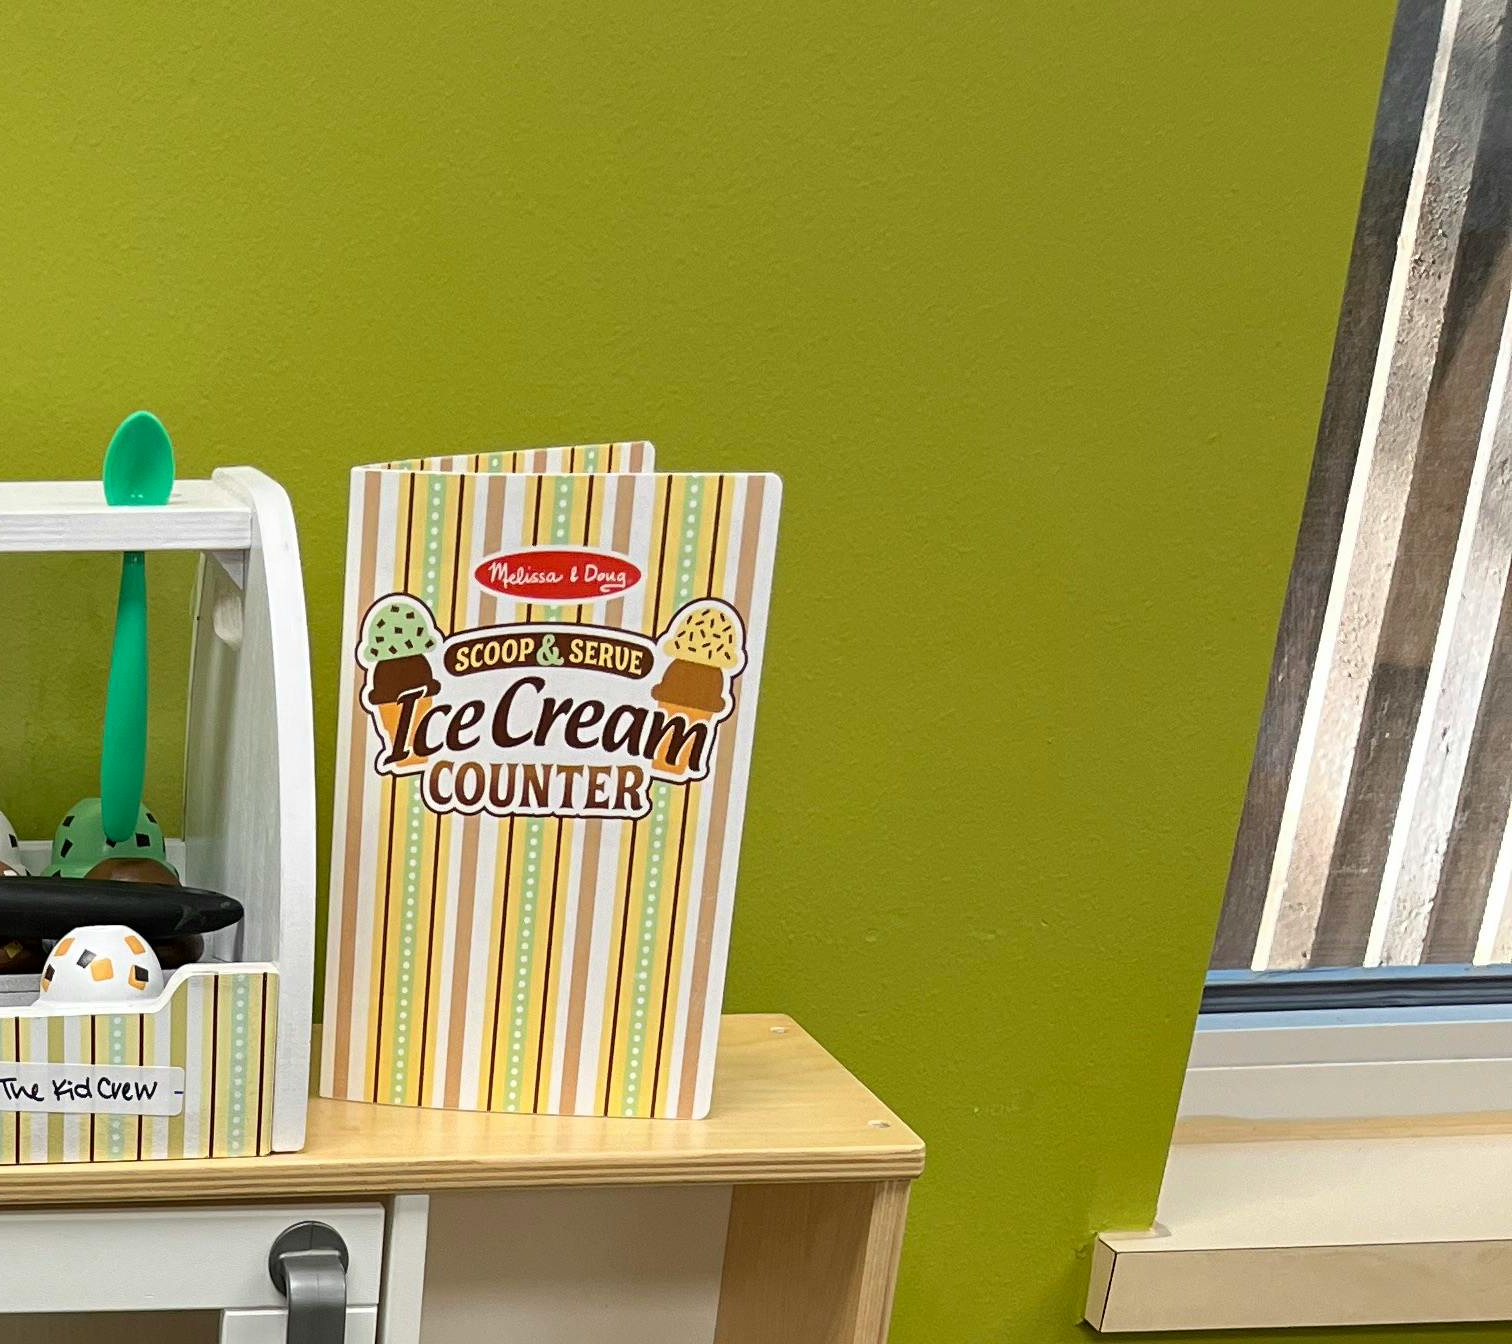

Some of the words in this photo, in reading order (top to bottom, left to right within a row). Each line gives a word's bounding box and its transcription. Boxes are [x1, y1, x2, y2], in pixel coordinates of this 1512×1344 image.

[489, 563, 564, 588] Melissa
[584, 564, 628, 593] Doug
[455, 638, 536, 673] SCOOP
[569, 639, 644, 675] SERVE
[384, 688, 486, 767] Ice
[490, 676, 708, 772] Cream
[428, 761, 645, 811] COUNTER
